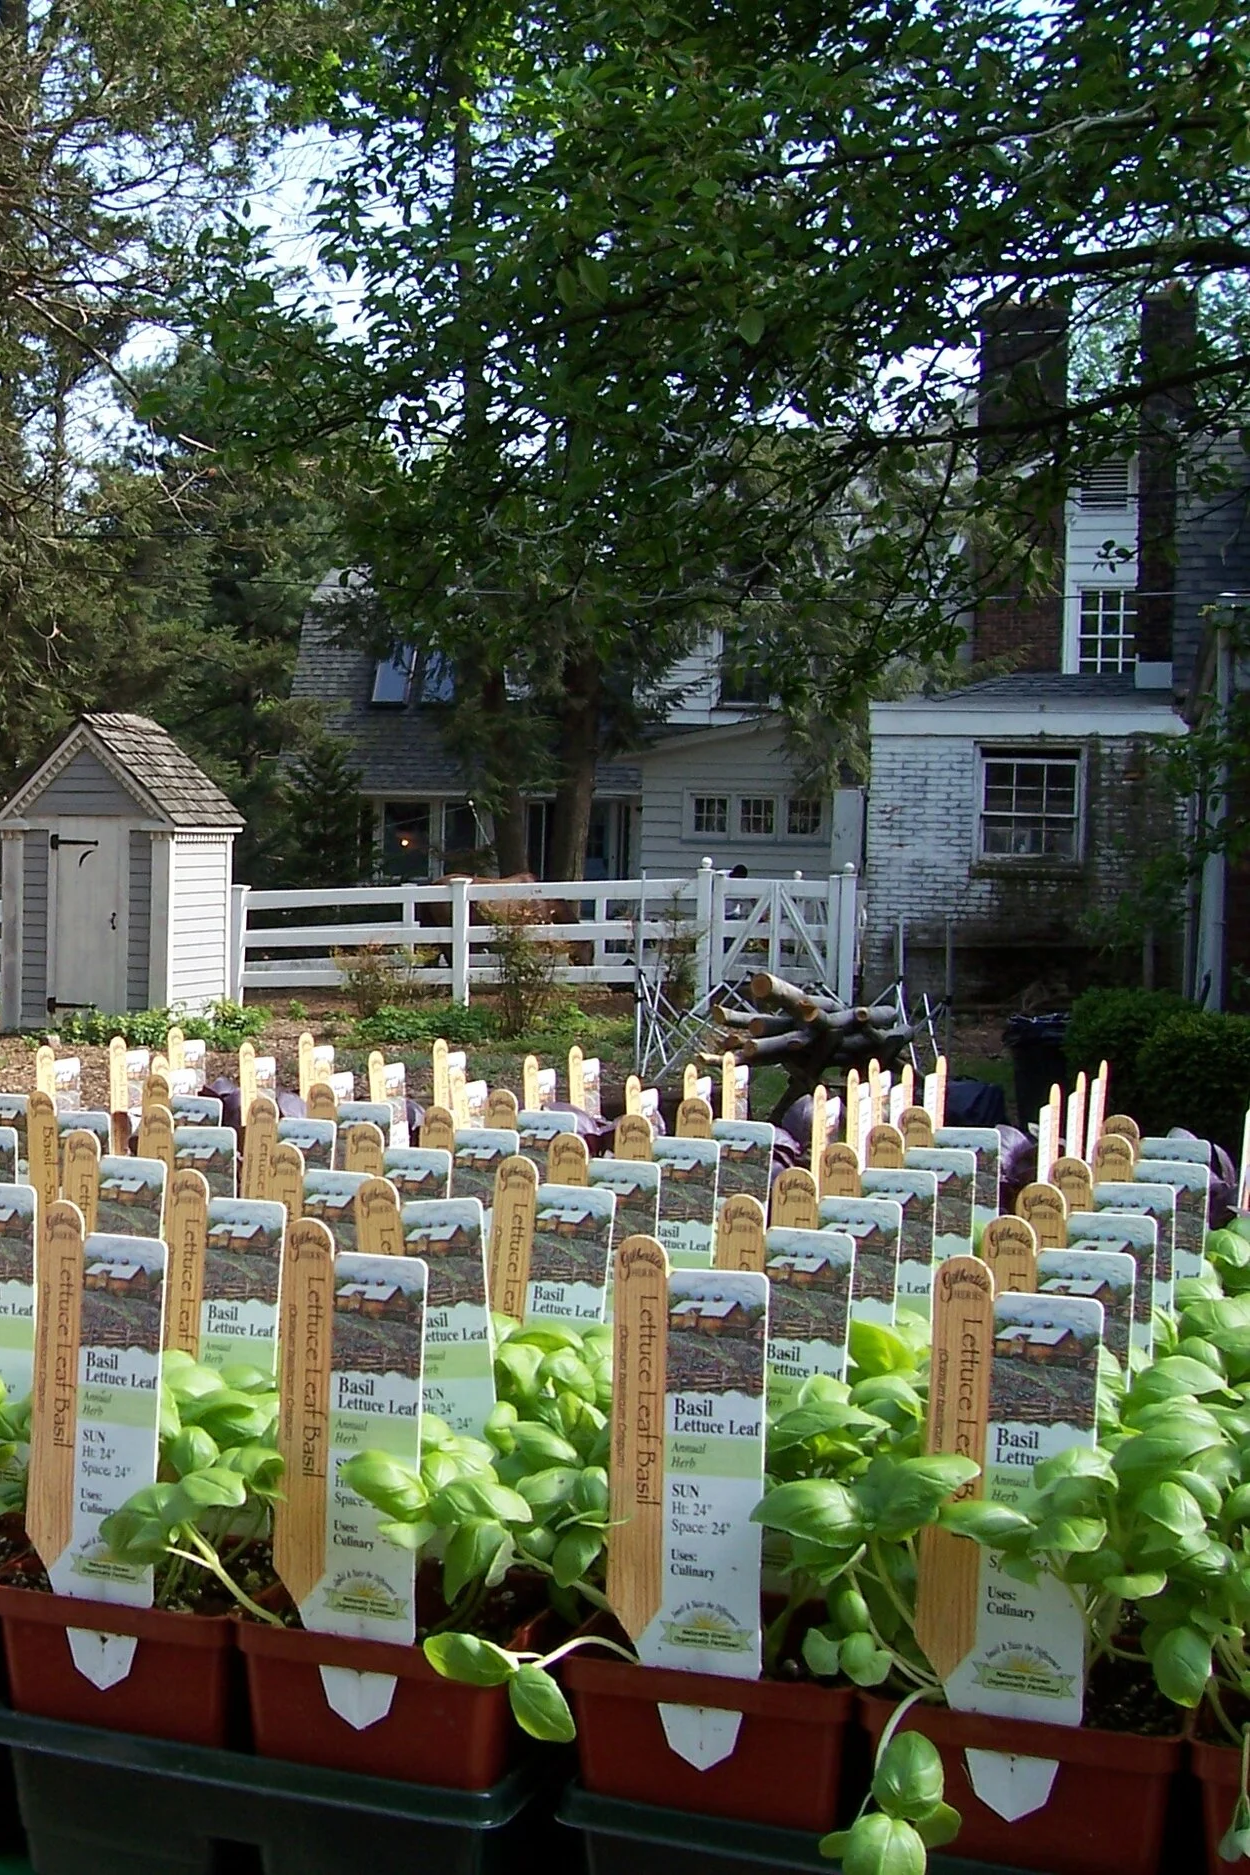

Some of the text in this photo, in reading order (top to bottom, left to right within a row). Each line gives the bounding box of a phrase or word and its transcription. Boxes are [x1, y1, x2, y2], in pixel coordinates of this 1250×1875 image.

[507, 1203, 528, 1273] Lettuce
[690, 1242, 710, 1251] Leaf
[178, 1219, 200, 1346] Lettuce Leaf
[907, 1282, 931, 1293] Leaf
[533, 1286, 565, 1302] Basil
[12, 1303, 33, 1316] Leaf
[208, 1305, 238, 1321] Basil
[533, 1301, 601, 1319] Lettuce Leaf
[427, 1312, 448, 1328] asil
[207, 1320, 273, 1338] Lettuce Leaf
[462, 1328, 488, 1341] Leaf
[54, 1256, 76, 1449] Lettuce Leaf Basil
[767, 1344, 800, 1360] Basil
[86, 1351, 118, 1370] Basil
[957, 1318, 983, 1412] Lettuce
[85, 1368, 157, 1390] Lettuce Leaf
[302, 1276, 326, 1479] Lettuce Leaf Basil
[339, 1376, 374, 1396] Basil
[338, 1394, 417, 1416] Lettuce Leaf
[636, 1295, 663, 1506] Lettuce Leaf Basil
[675, 1398, 713, 1417] Basil
[82, 1404, 103, 1416] Herb
[674, 1417, 761, 1436] Lettuce Leaf
[83, 1429, 106, 1443] SUN
[335, 1433, 358, 1444] Herb
[997, 1428, 1039, 1449] Basil
[671, 1442, 706, 1454] Annual
[671, 1456, 696, 1468] Herb
[992, 1475, 1030, 1488] Annual
[81, 1488, 102, 1501] Uses:
[672, 1484, 699, 1498] SUN
[991, 1490, 1018, 1504] Herb
[334, 1520, 359, 1533] Uses:
[672, 1519, 708, 1534] Space:
[333, 1533, 375, 1551] Culinary
[671, 1549, 698, 1561] Uses:
[670, 1563, 715, 1580] Culinary
[988, 1587, 1017, 1600] Uses:
[987, 1603, 1035, 1621] Culinary
